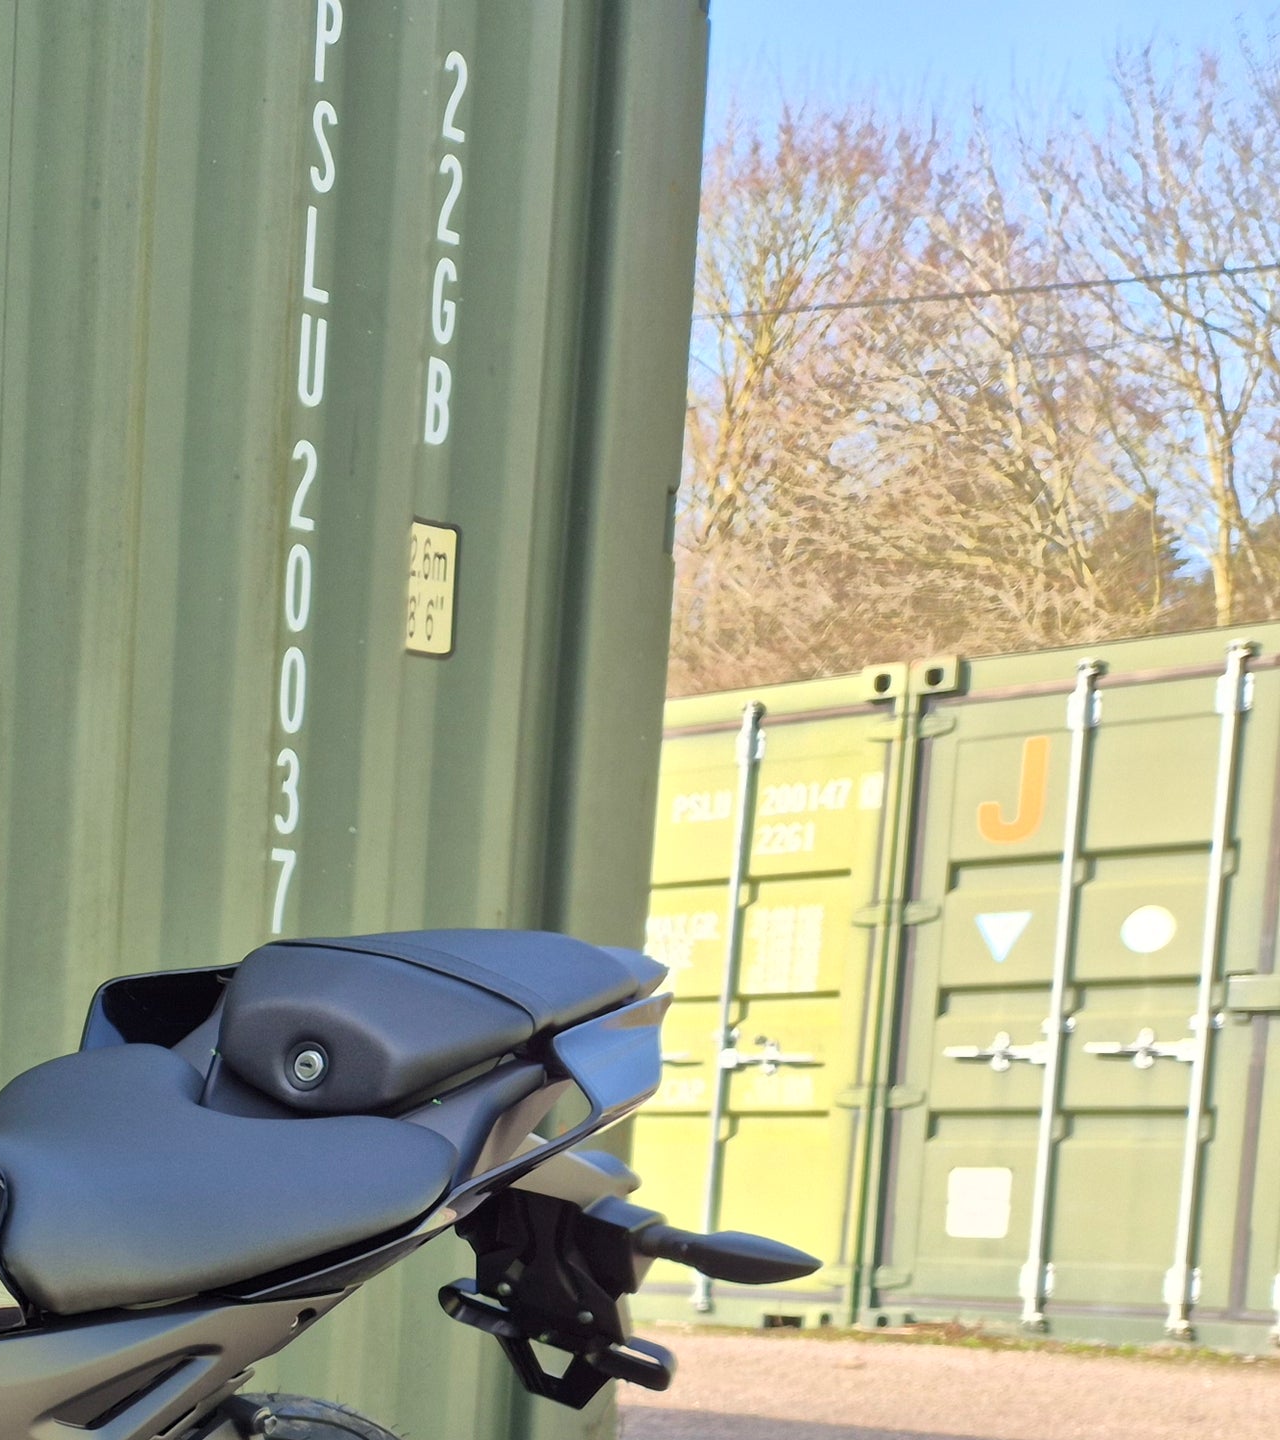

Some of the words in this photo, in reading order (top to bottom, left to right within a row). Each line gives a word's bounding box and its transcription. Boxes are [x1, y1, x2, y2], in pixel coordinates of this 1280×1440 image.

[297, 0, 342, 408] PSLU
[424, 51, 469, 446] 22GB
[977, 736, 1049, 844] J
